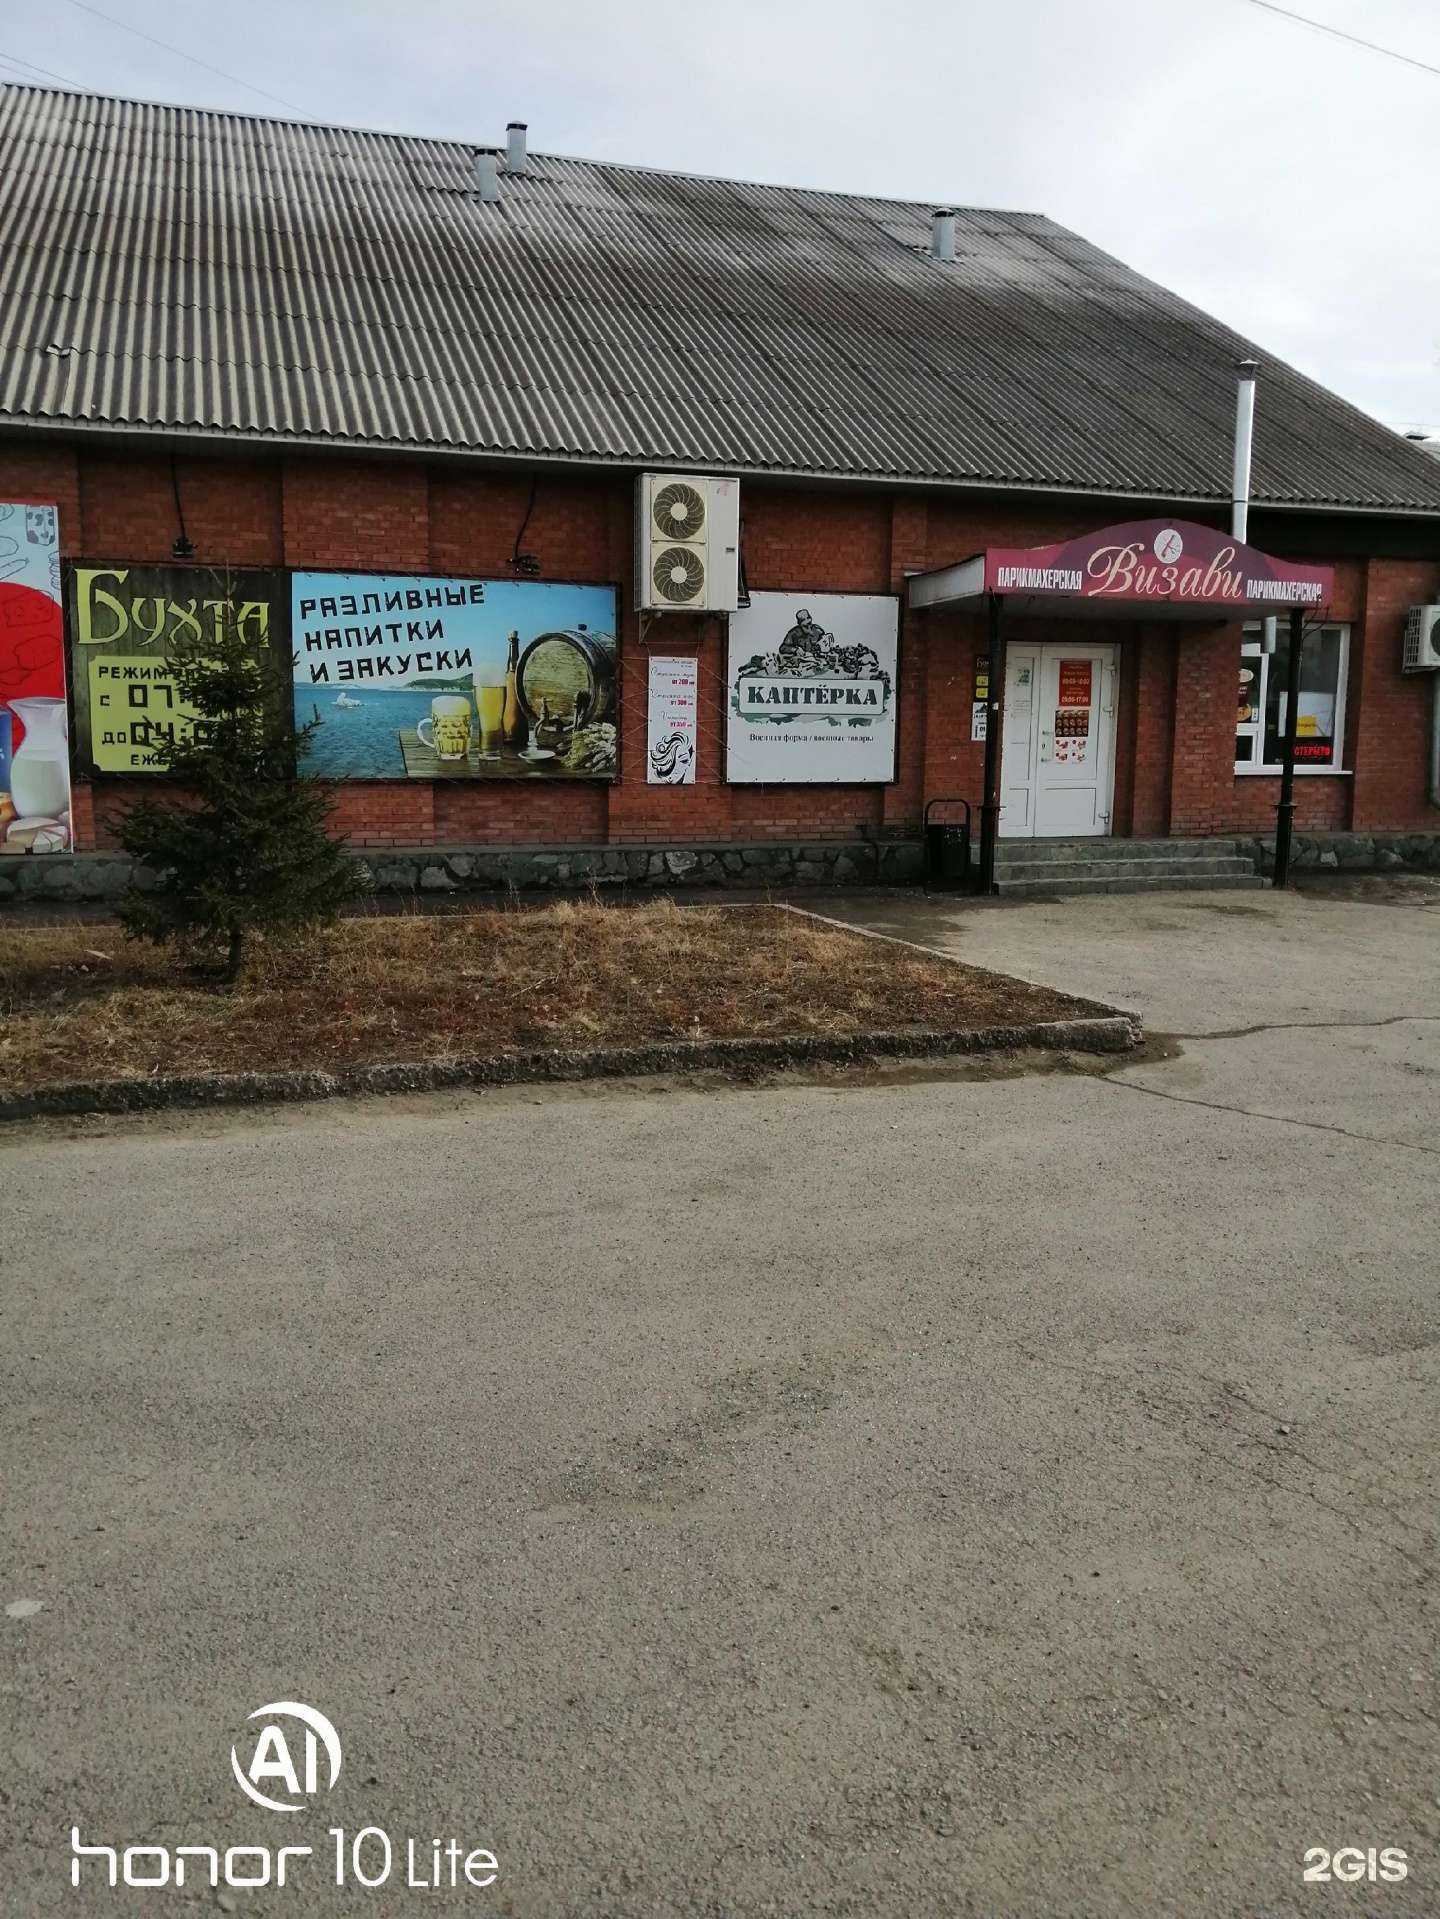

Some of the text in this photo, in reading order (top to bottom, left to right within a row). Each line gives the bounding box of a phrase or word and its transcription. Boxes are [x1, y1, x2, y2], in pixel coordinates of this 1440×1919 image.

[997, 542, 1323, 603] ПАРИКМАХЕРСКАЯ Визави ПАРИКМАХЕРСКАЯ
[300, 583, 485, 620] РАЗЛИВНЫЕ
[304, 618, 444, 651] НАПИТКИ
[309, 647, 473, 684] И ЗАКУСКИ
[747, 684, 878, 706] КАПТЁРКА
